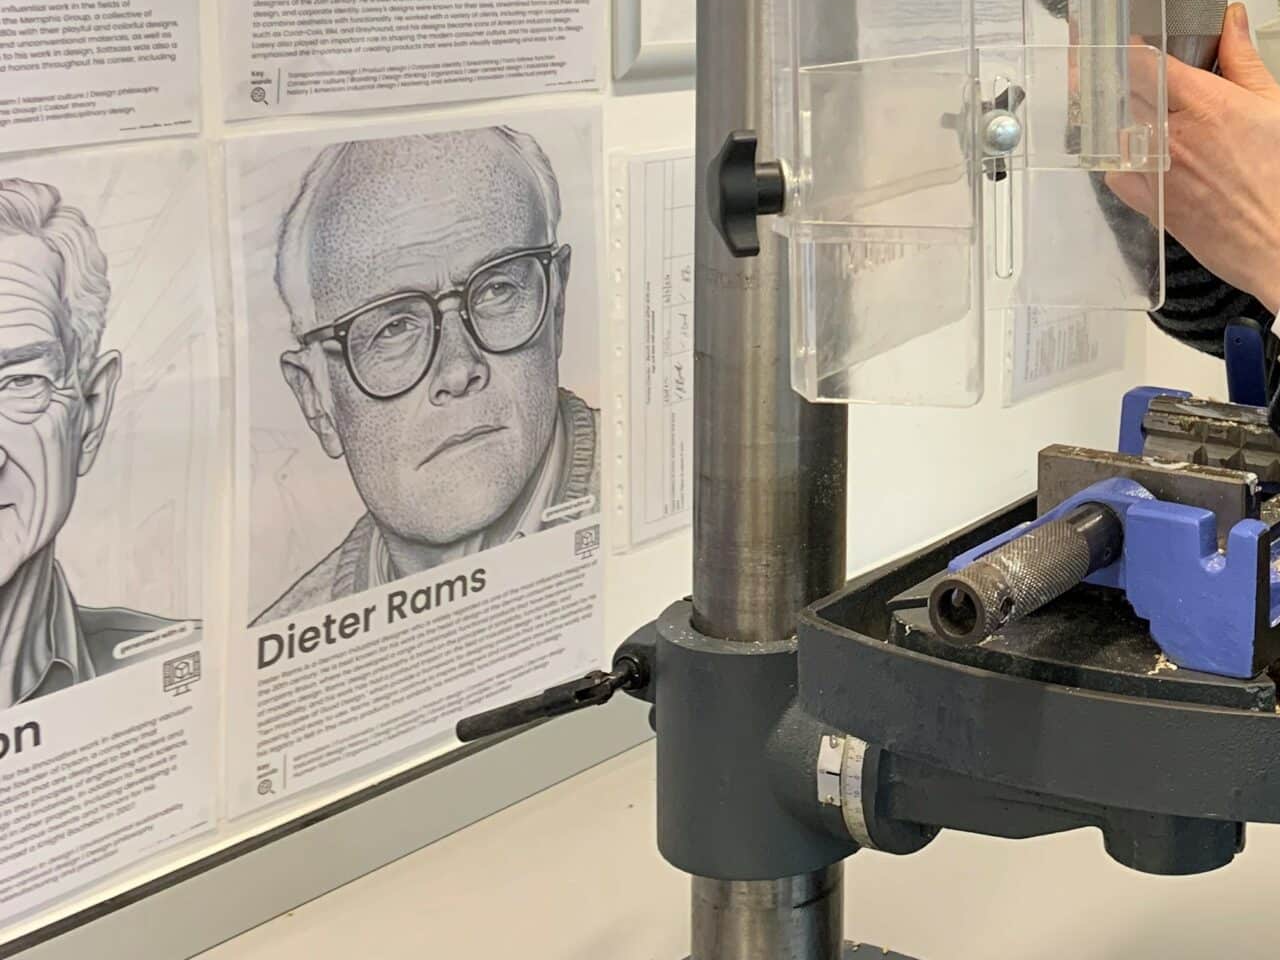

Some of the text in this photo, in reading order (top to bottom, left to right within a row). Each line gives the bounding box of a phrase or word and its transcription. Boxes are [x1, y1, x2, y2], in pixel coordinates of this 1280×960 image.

[1, 3, 46, 14] influential
[48, 3, 69, 11] work
[80, 1, 96, 9] the
[97, 0, 120, 8] fields
[121, 0, 130, 7] of
[253, 0, 290, 8] designers
[2, 17, 18, 25] the
[20, 14, 61, 25] Memphis
[102, 10, 143, 20] collective
[144, 9, 153, 17] of
[62, 25, 92, 35] playful
[93, 24, 111, 32] and
[112, 22, 144, 30] colorful
[18, 37, 86, 48] unconventional
[144, 32, 161, 40] well
[3, 53, 13, 61] to
[15, 51, 28, 60] his
[30, 50, 50, 58] work
[152, 42, 170, 50] also
[8, 62, 40, 72] honors
[41, 59, 91, 71] throughout
[137, 53, 177, 64] including
[257, 568, 486, 669] Dieter Rams
[2, 773, 15, 781] for
[17, 767, 30, 776] his
[32, 749, 77, 770] innovative
[80, 740, 99, 752] work
[111, 719, 157, 741] developing
[159, 705, 193, 722] vacuum
